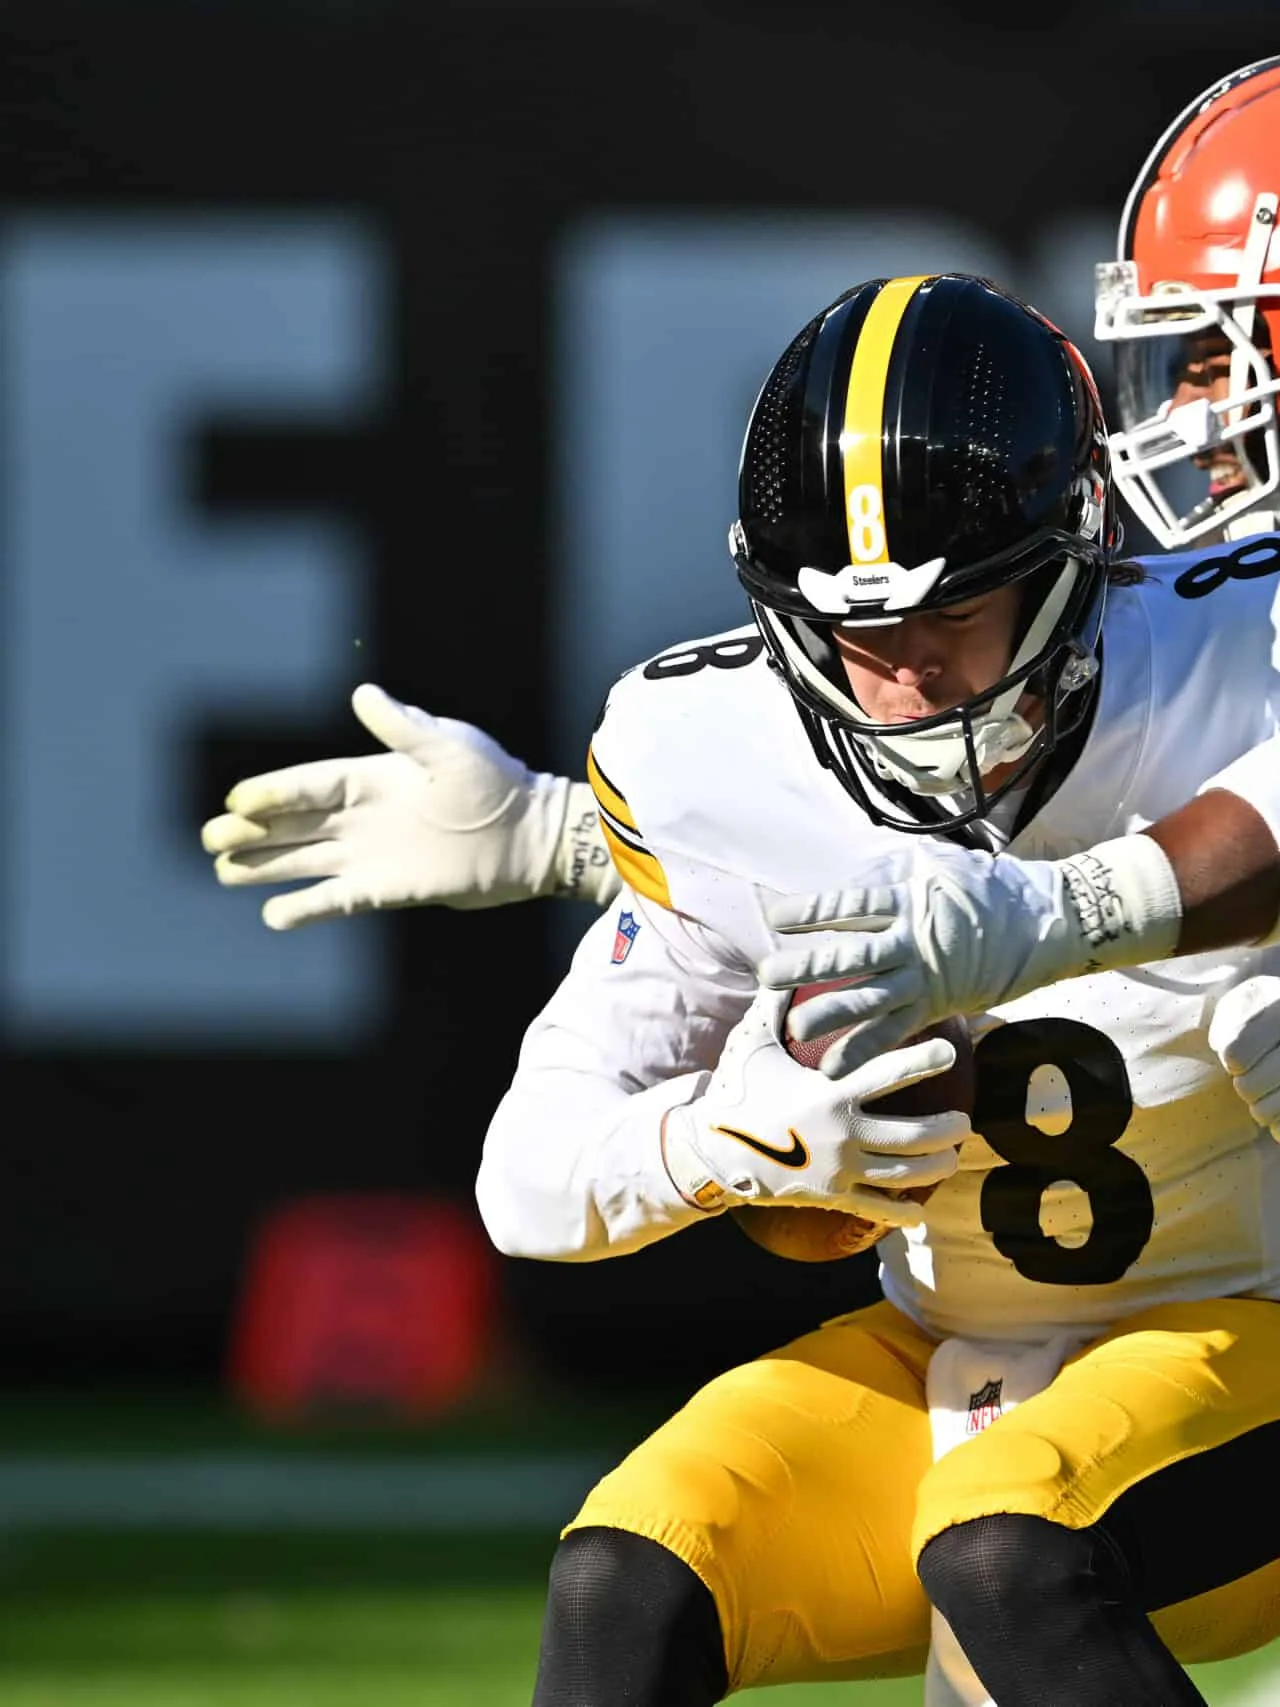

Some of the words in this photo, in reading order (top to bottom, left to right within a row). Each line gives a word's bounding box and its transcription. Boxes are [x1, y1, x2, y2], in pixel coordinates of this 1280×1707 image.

[848, 484, 885, 561] 8
[852, 574, 890, 586] Steelers
[643, 635, 765, 680] 8
[971, 1017, 1154, 1286] 8
